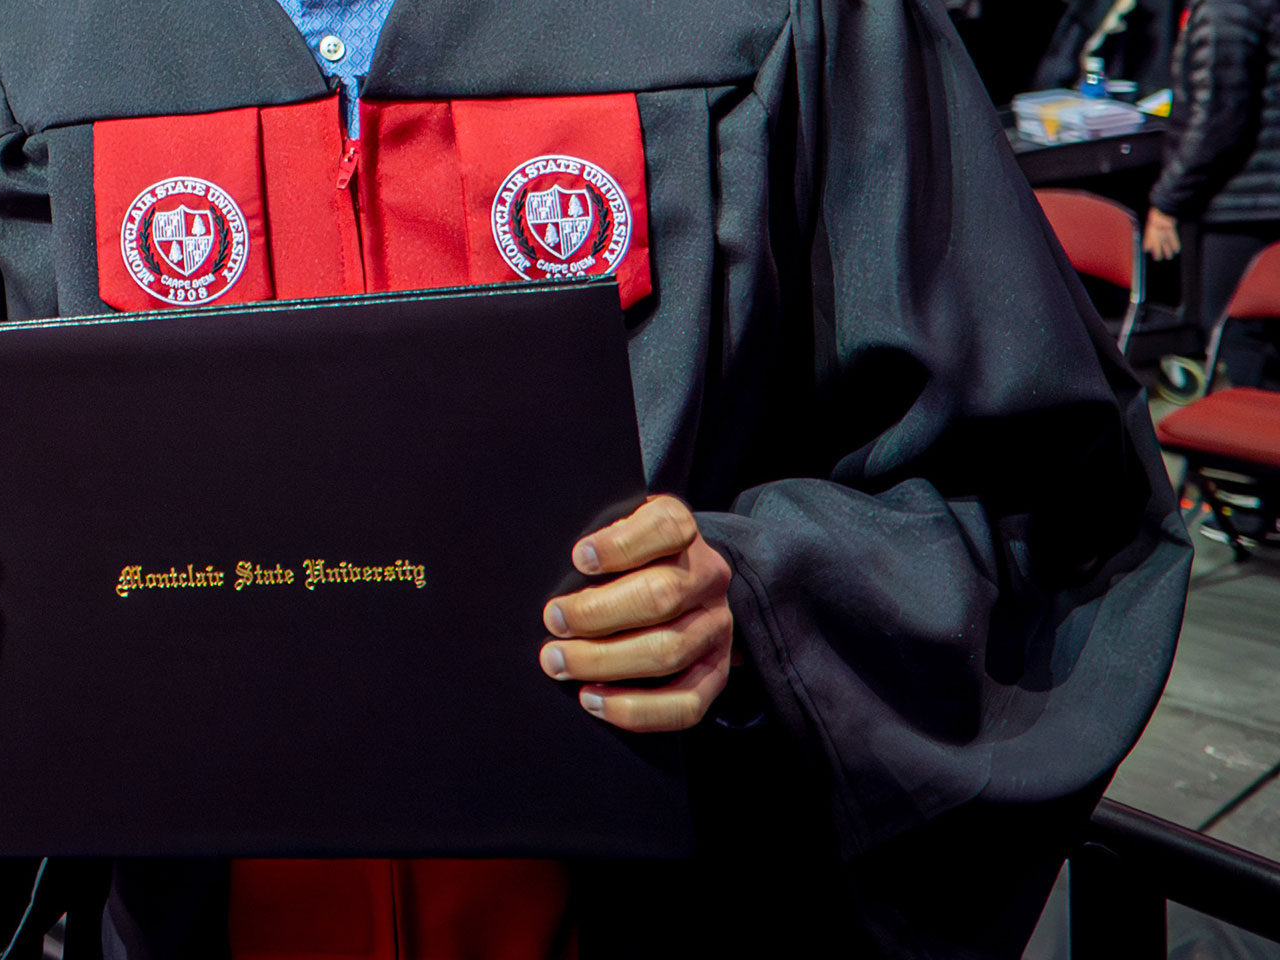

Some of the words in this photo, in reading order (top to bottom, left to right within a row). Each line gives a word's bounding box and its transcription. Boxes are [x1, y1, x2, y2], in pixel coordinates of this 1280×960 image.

[125, 193, 157, 285] MONTCLAIR
[155, 181, 206, 199] STATE
[207, 187, 244, 282] UNIVERSITY
[496, 173, 531, 271] MONTCLAIR
[525, 160, 581, 179] STATE
[583, 166, 626, 265] UNIVERSITY
[168, 287, 208, 300] 1908
[115, 564, 225, 598] Montclair
[234, 561, 295, 592] State
[302, 559, 427, 591] University
